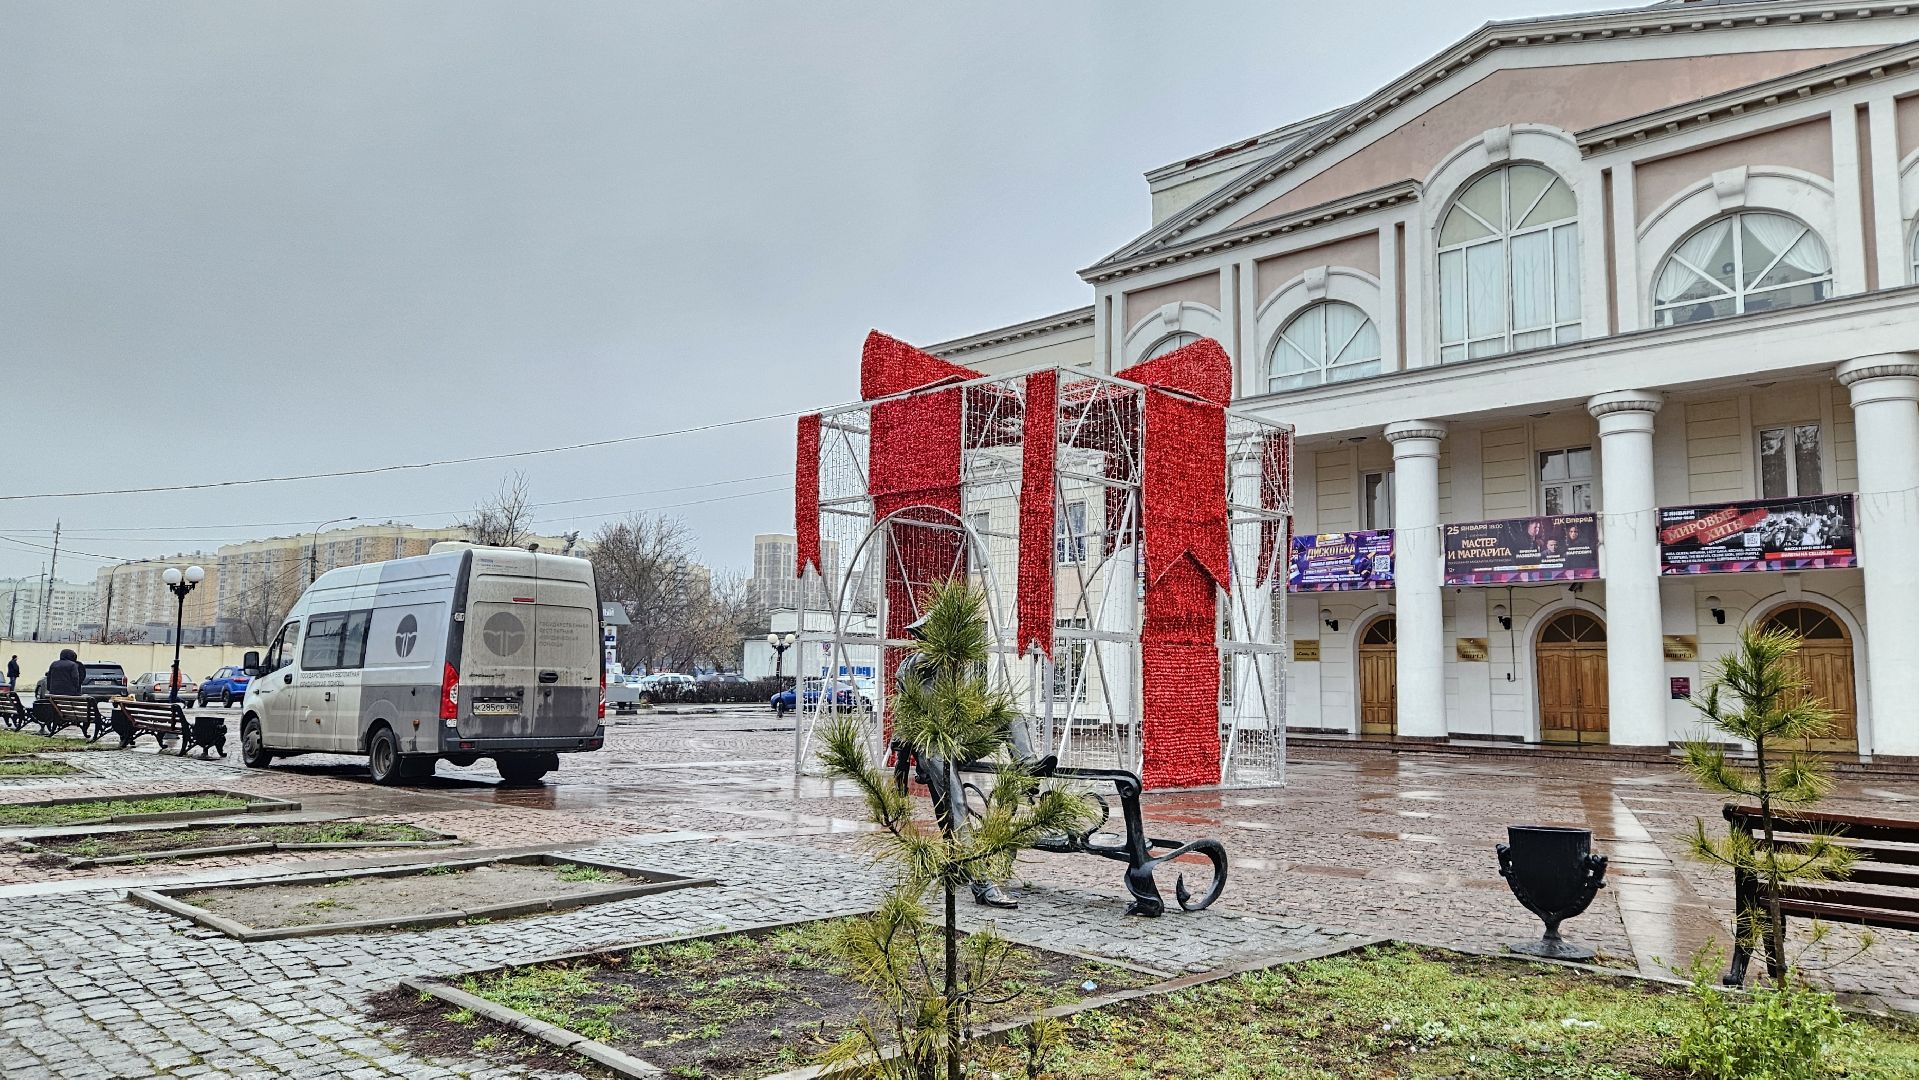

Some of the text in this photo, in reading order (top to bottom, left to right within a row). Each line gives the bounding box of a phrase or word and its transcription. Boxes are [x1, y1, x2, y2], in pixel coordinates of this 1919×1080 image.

[1447, 526, 1459, 535] 25
[1668, 508, 1736, 541] МИРОВЫЕ
[1705, 517, 1747, 541] ХИТЫ
[1461, 537, 1497, 548] МАСТЕР
[1307, 543, 1356, 559] ДИСКОТЕКА
[1448, 550, 1456, 560] И
[1457, 547, 1512, 559] МАРГАРИТА
